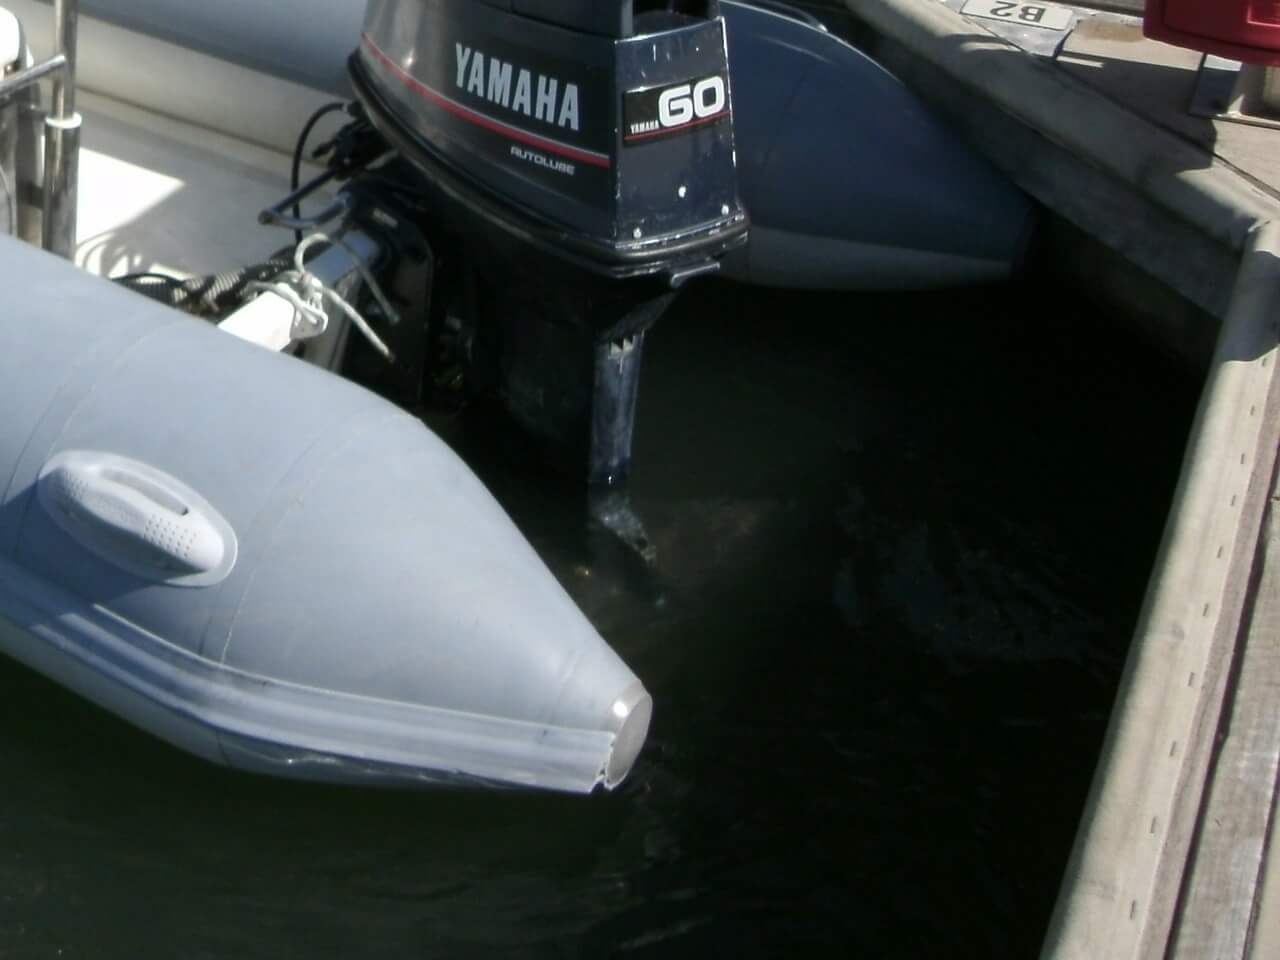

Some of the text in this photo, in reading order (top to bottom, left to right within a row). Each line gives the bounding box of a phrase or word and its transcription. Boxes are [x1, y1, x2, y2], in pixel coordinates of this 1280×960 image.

[990, 0, 1046, 23] B2
[455, 42, 579, 132] YAMAHA
[658, 76, 725, 128] 60
[630, 120, 659, 134] YAMAHA
[510, 146, 576, 176] AUTOLUBE
